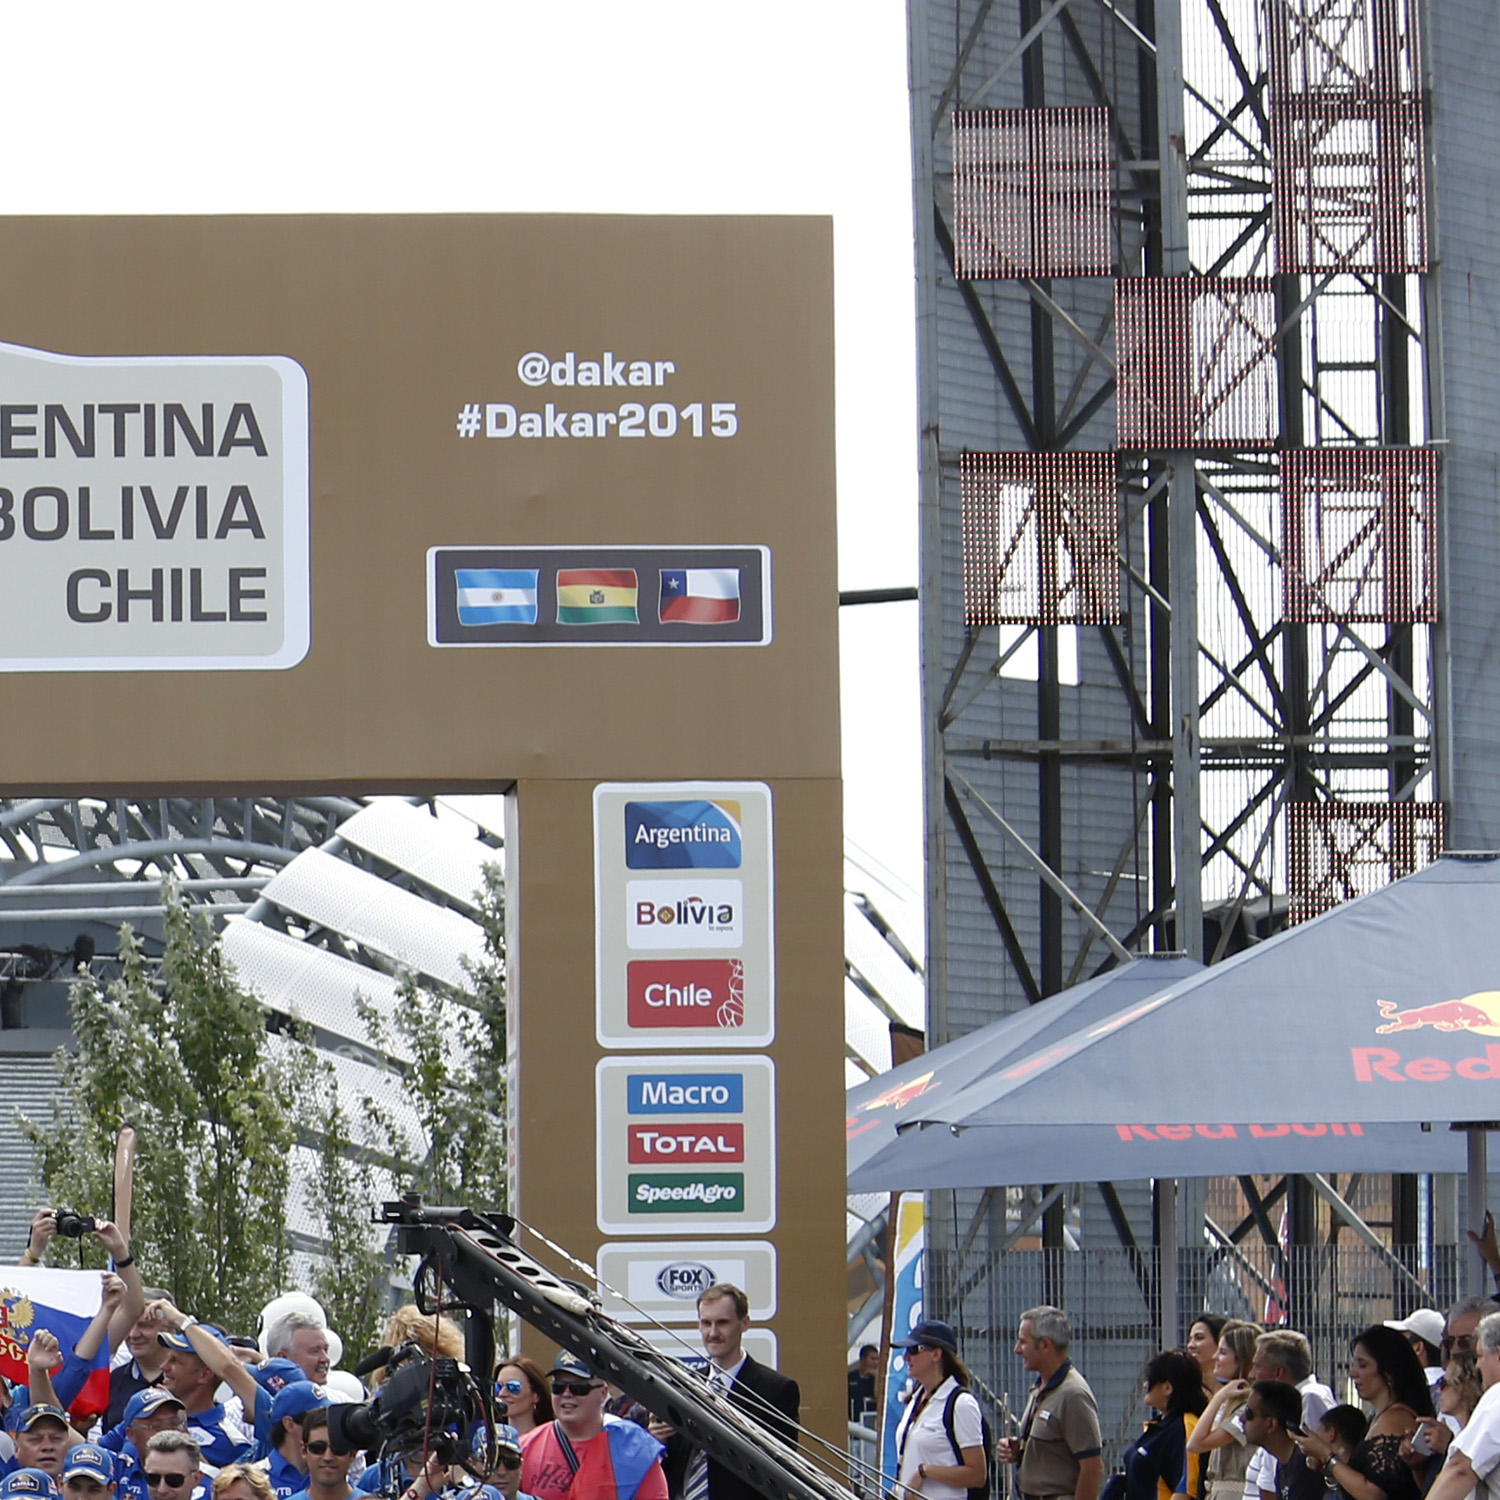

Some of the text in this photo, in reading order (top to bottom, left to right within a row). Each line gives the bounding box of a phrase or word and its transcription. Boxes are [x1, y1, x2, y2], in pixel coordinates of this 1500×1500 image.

[517, 352, 675, 387] @dakar
[456, 402, 738, 438] #Dakar2015
[65, 566, 268, 623] CHILE
[635, 823, 731, 848] Argentina
[636, 896, 733, 925] Bolivia
[645, 984, 712, 1007] Chile
[642, 1082, 729, 1105] Macro
[636, 1133, 735, 1153] TOTAL
[636, 1183, 736, 1203] SpeedAgro
[669, 1269, 702, 1284] FOX
